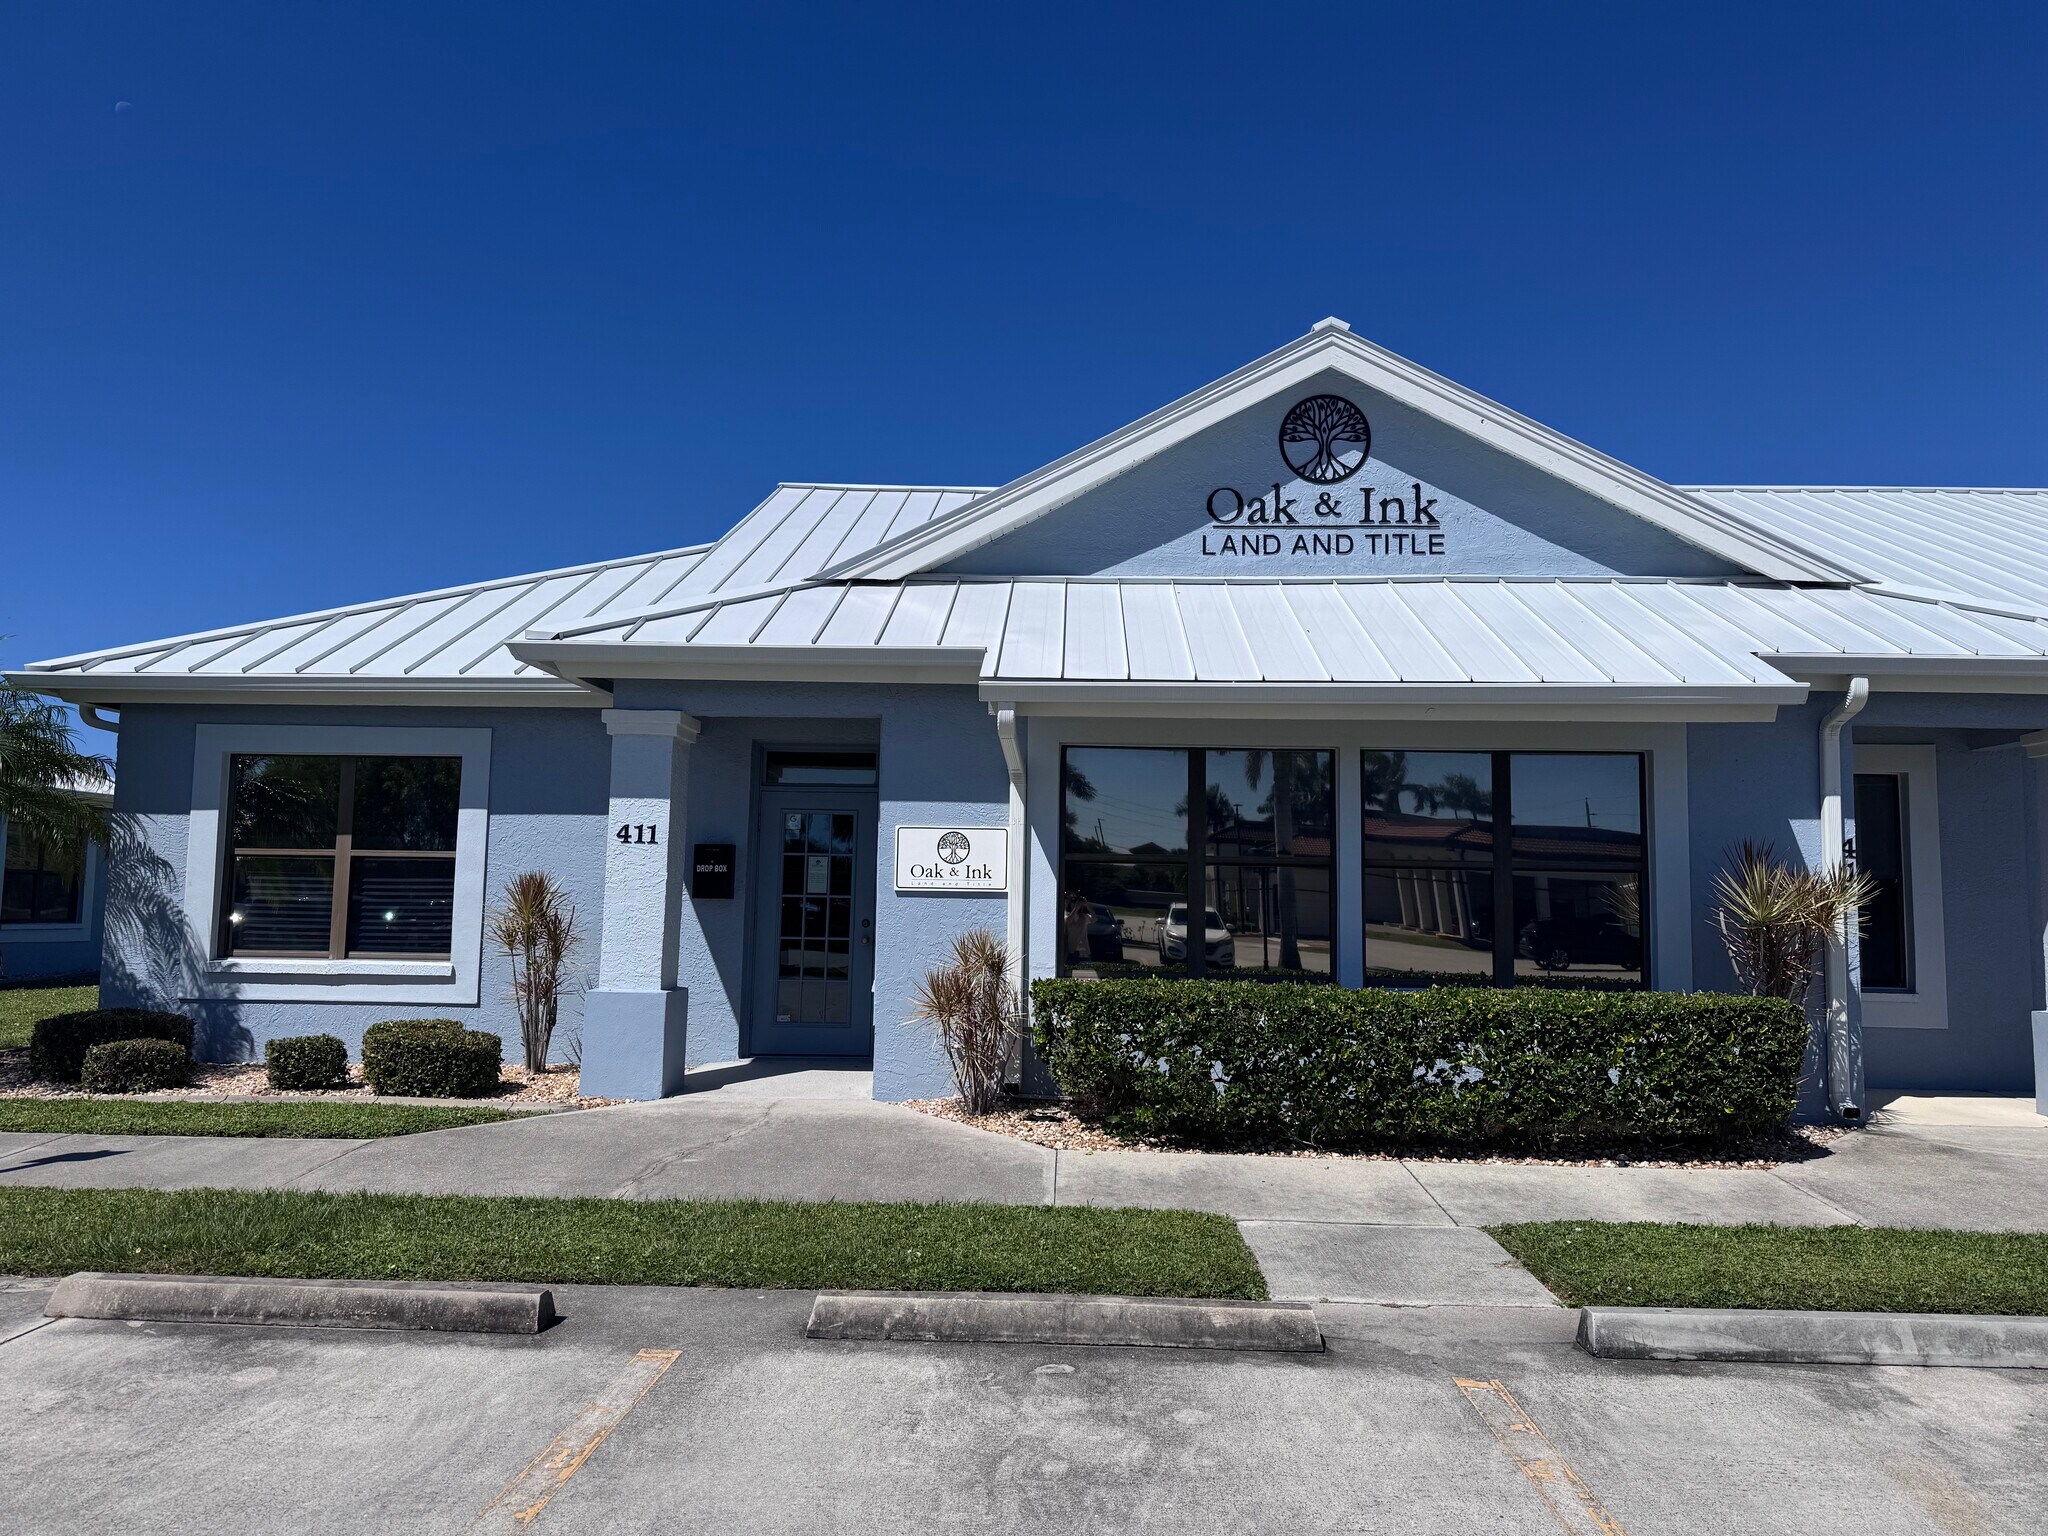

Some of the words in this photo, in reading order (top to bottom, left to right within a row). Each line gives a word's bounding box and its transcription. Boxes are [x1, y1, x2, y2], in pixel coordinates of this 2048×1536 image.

[1206, 482, 1299, 525] Oak
[1314, 491, 1343, 518] &
[1359, 482, 1441, 525] Ink
[1202, 534, 1281, 556] LAND
[1291, 534, 1354, 556] AND
[1365, 533, 1446, 556] TITLE
[616, 823, 659, 845] 411
[696, 864, 713, 873] DROP
[714, 864, 728, 873] BOX
[910, 863, 944, 879] Oak
[949, 866, 960, 877] &
[965, 864, 993, 879] Ink
